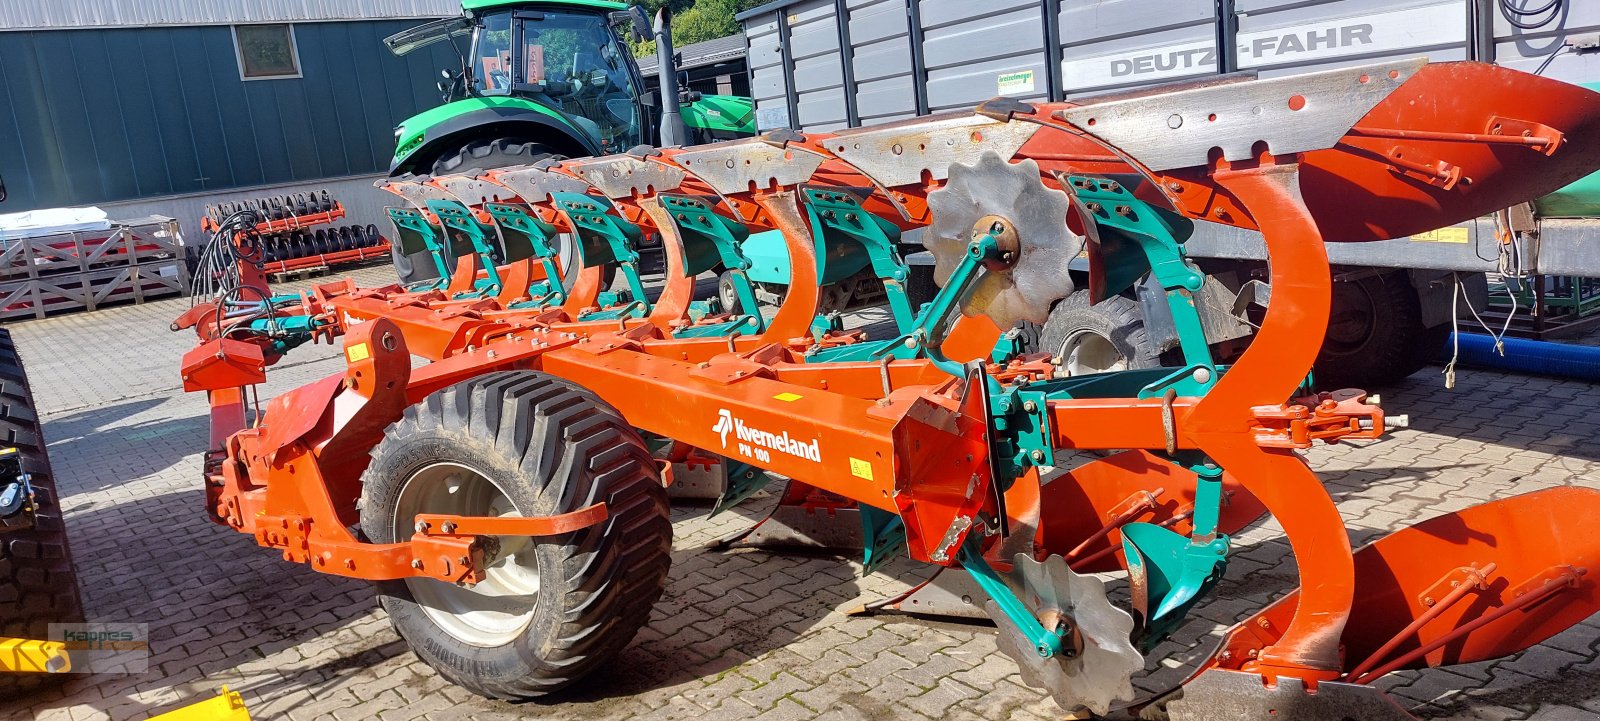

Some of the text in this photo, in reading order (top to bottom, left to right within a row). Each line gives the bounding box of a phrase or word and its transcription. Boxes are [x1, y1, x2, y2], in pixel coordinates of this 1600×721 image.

[1110, 23, 1374, 77] DEUTZ-FAHR
[733, 417, 822, 463] Kverneland
[738, 442, 771, 464] PN 100
